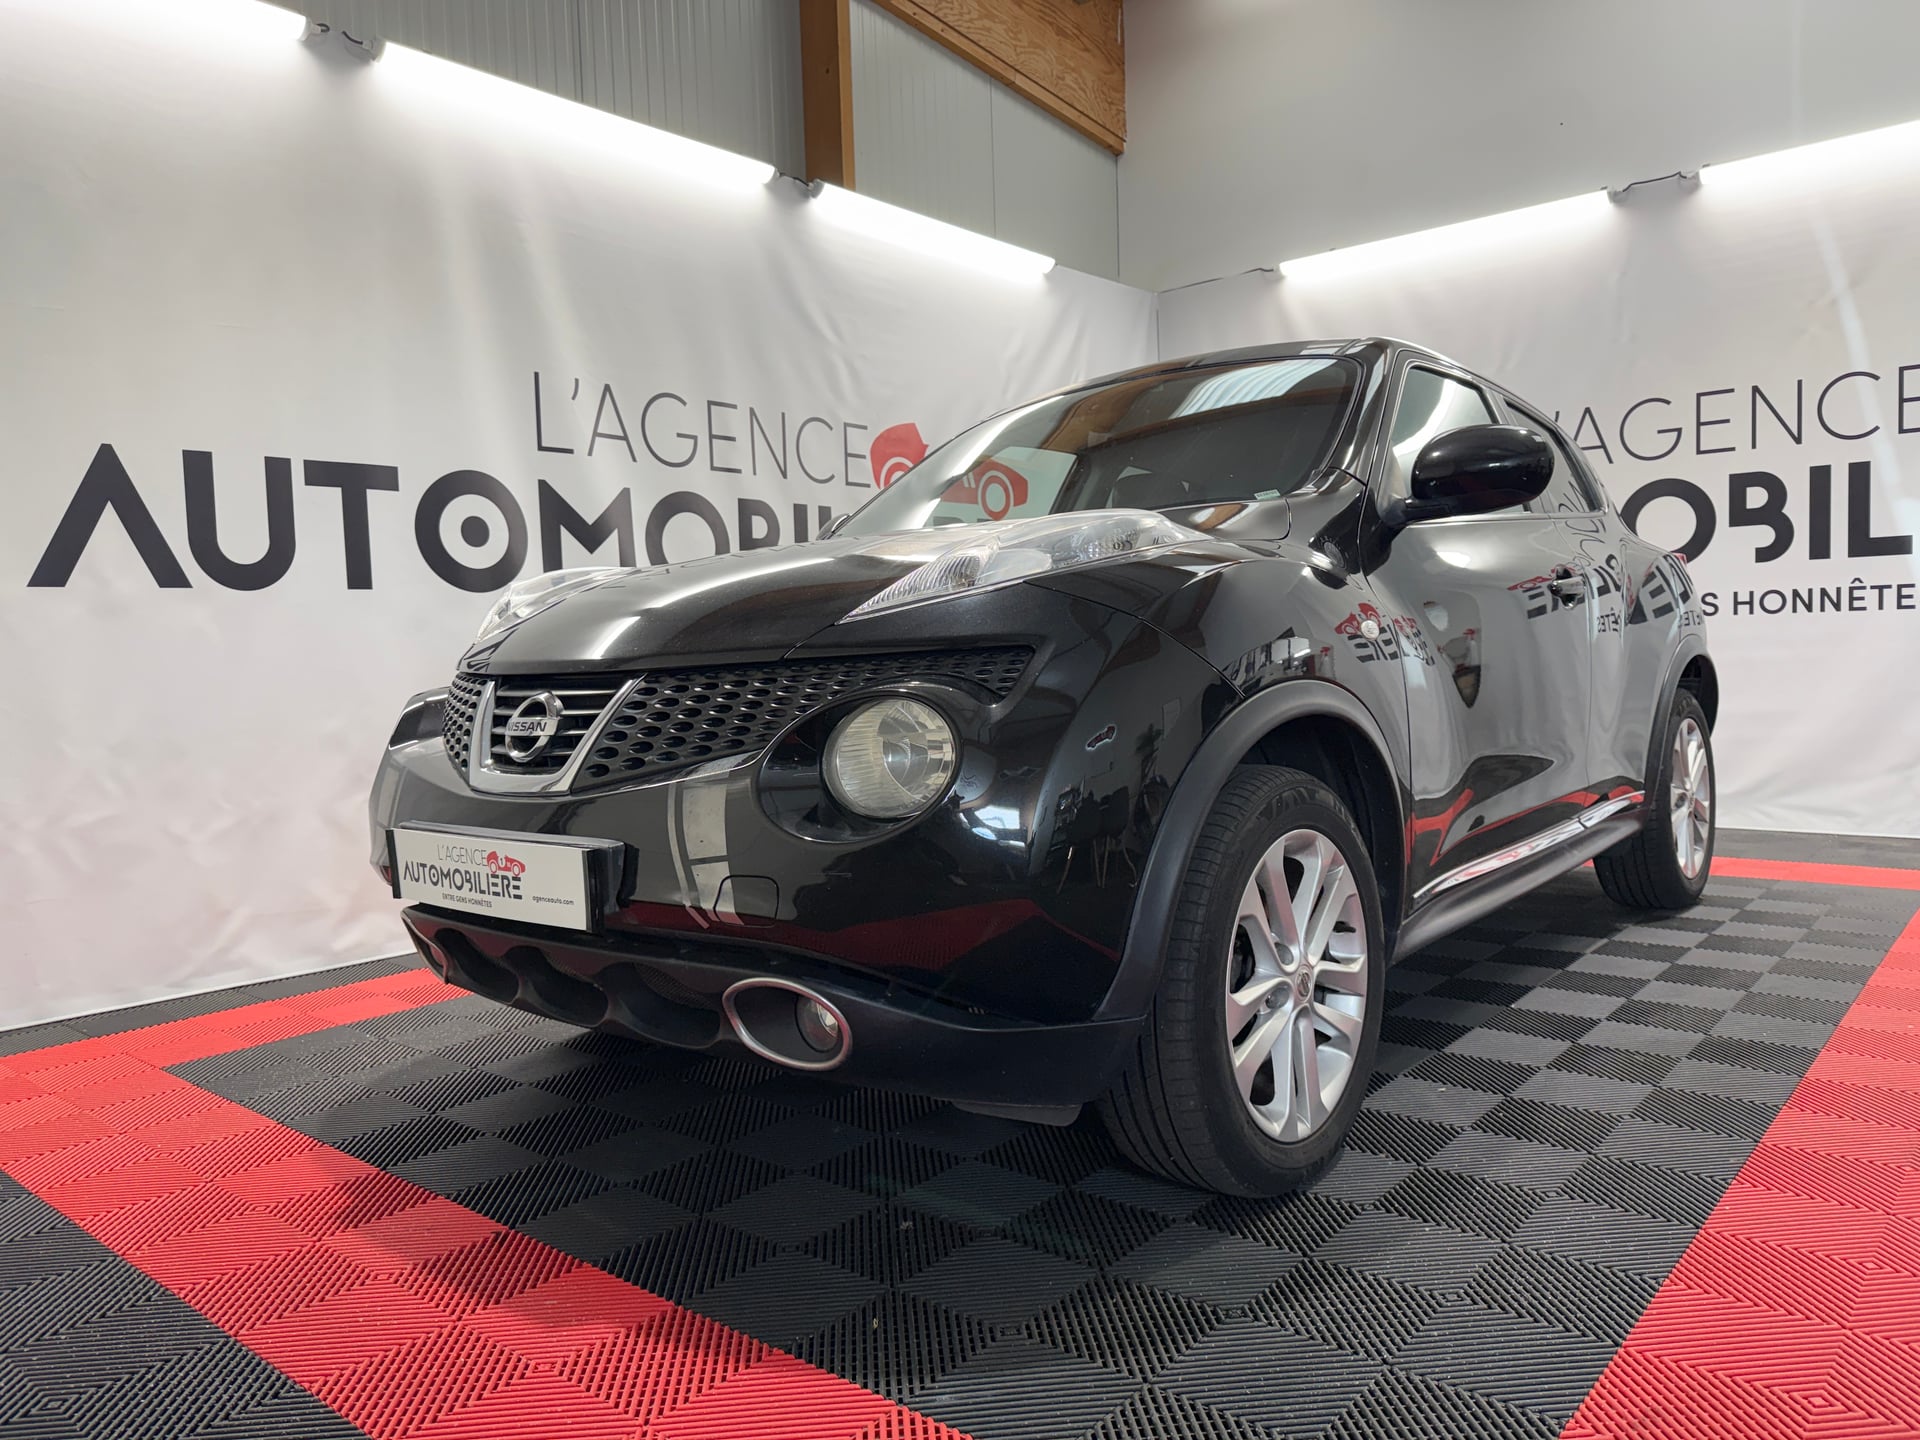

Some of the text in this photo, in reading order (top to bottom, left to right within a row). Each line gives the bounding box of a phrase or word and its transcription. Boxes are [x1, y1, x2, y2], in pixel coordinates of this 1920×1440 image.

[533, 371, 871, 488] L'AGENCE
[1555, 364, 1920, 465] 'AGENCE
[437, 844, 488, 867] L'AGENCE
